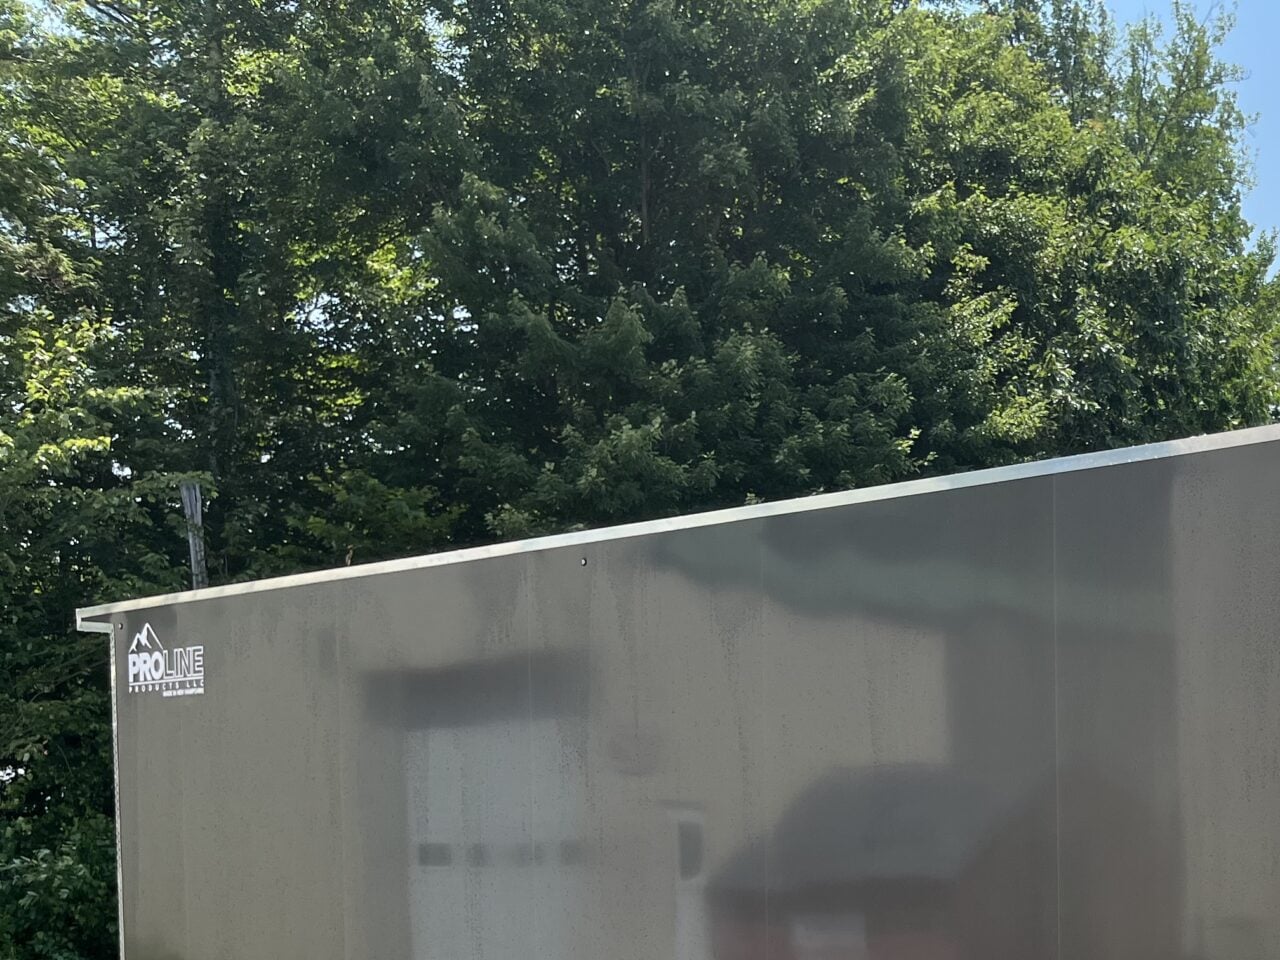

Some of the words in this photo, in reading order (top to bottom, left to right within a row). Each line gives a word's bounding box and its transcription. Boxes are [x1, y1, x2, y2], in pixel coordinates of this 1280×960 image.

[128, 645, 204, 683] PROLINE
[128, 682, 180, 694] PRODUCTS
[186, 679, 204, 688] LLC
